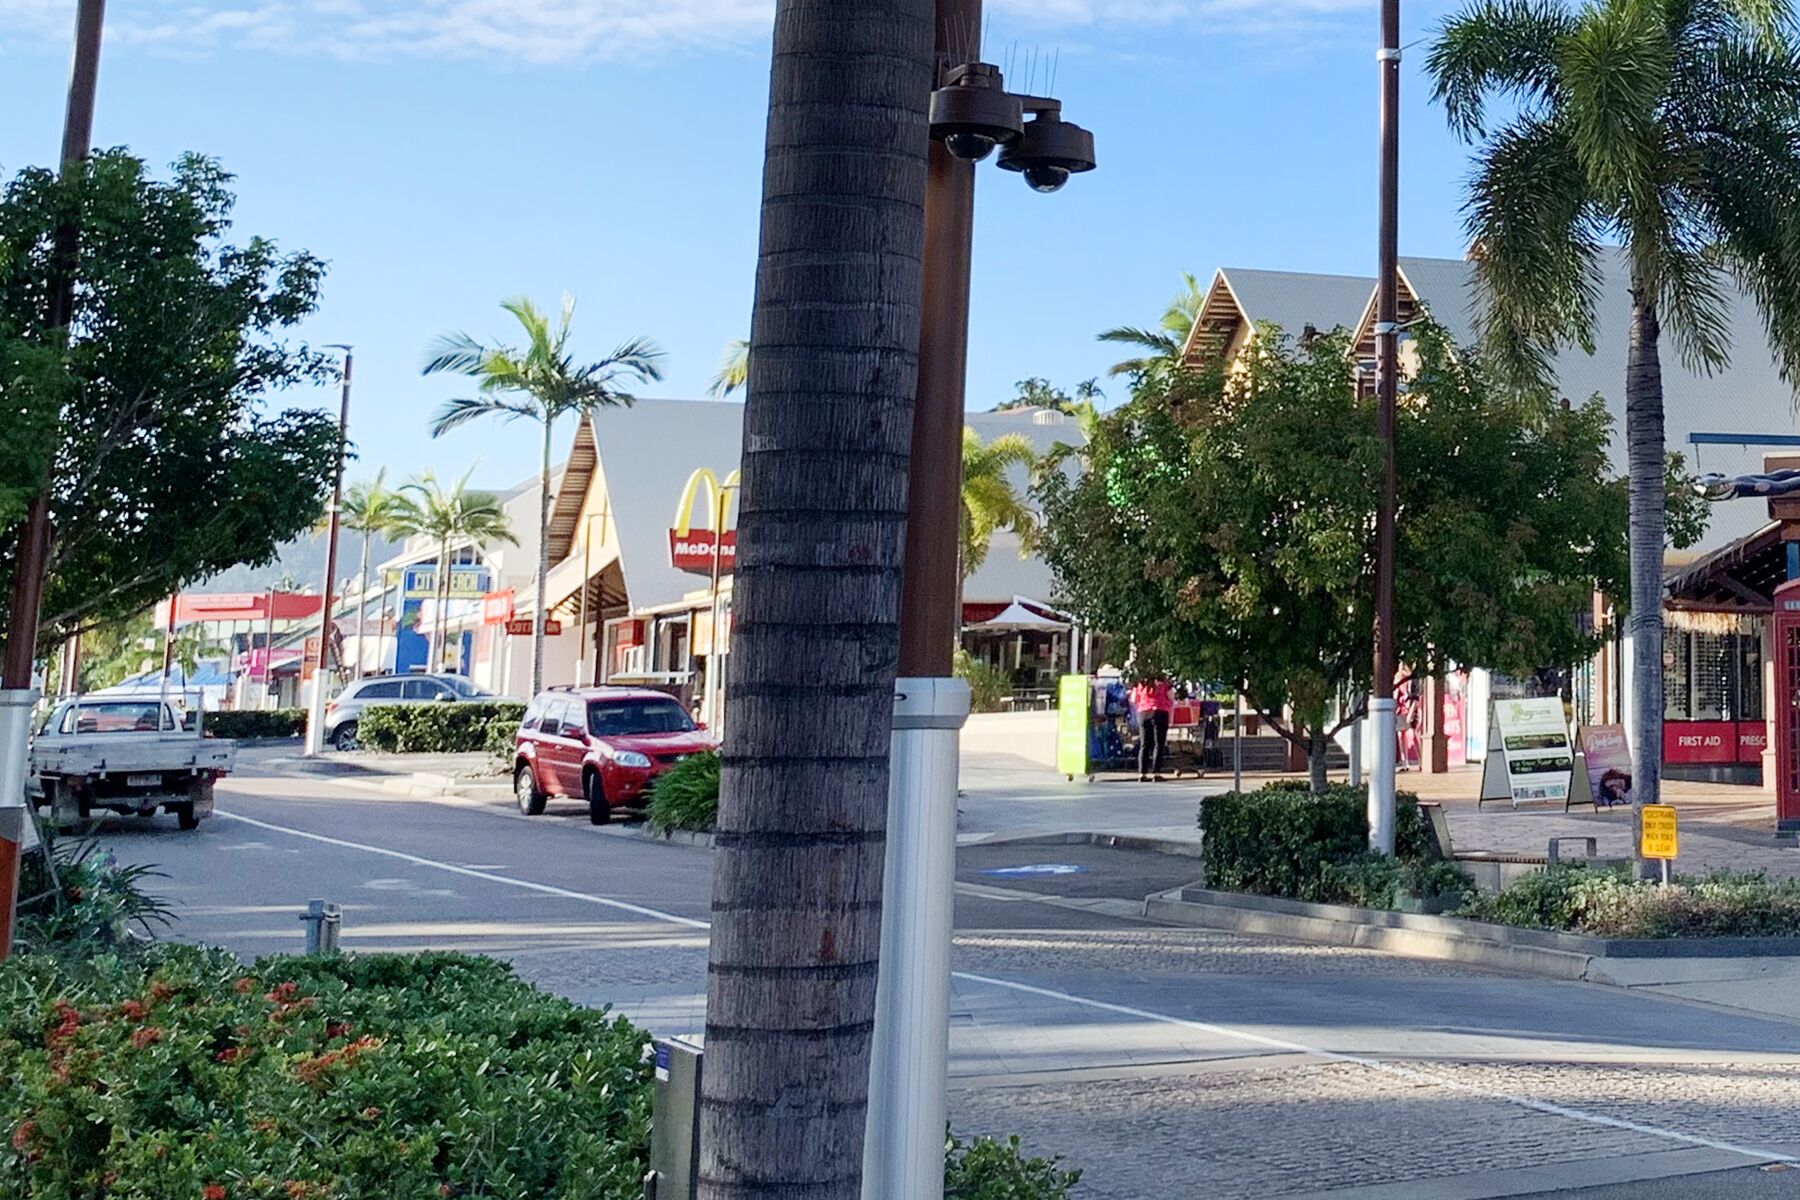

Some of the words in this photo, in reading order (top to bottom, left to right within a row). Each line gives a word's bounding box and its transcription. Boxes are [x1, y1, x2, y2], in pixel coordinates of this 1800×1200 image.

[452, 573, 478, 591] EACH
[1678, 736, 1701, 747] FIRST
[1704, 735, 1721, 746] AID
